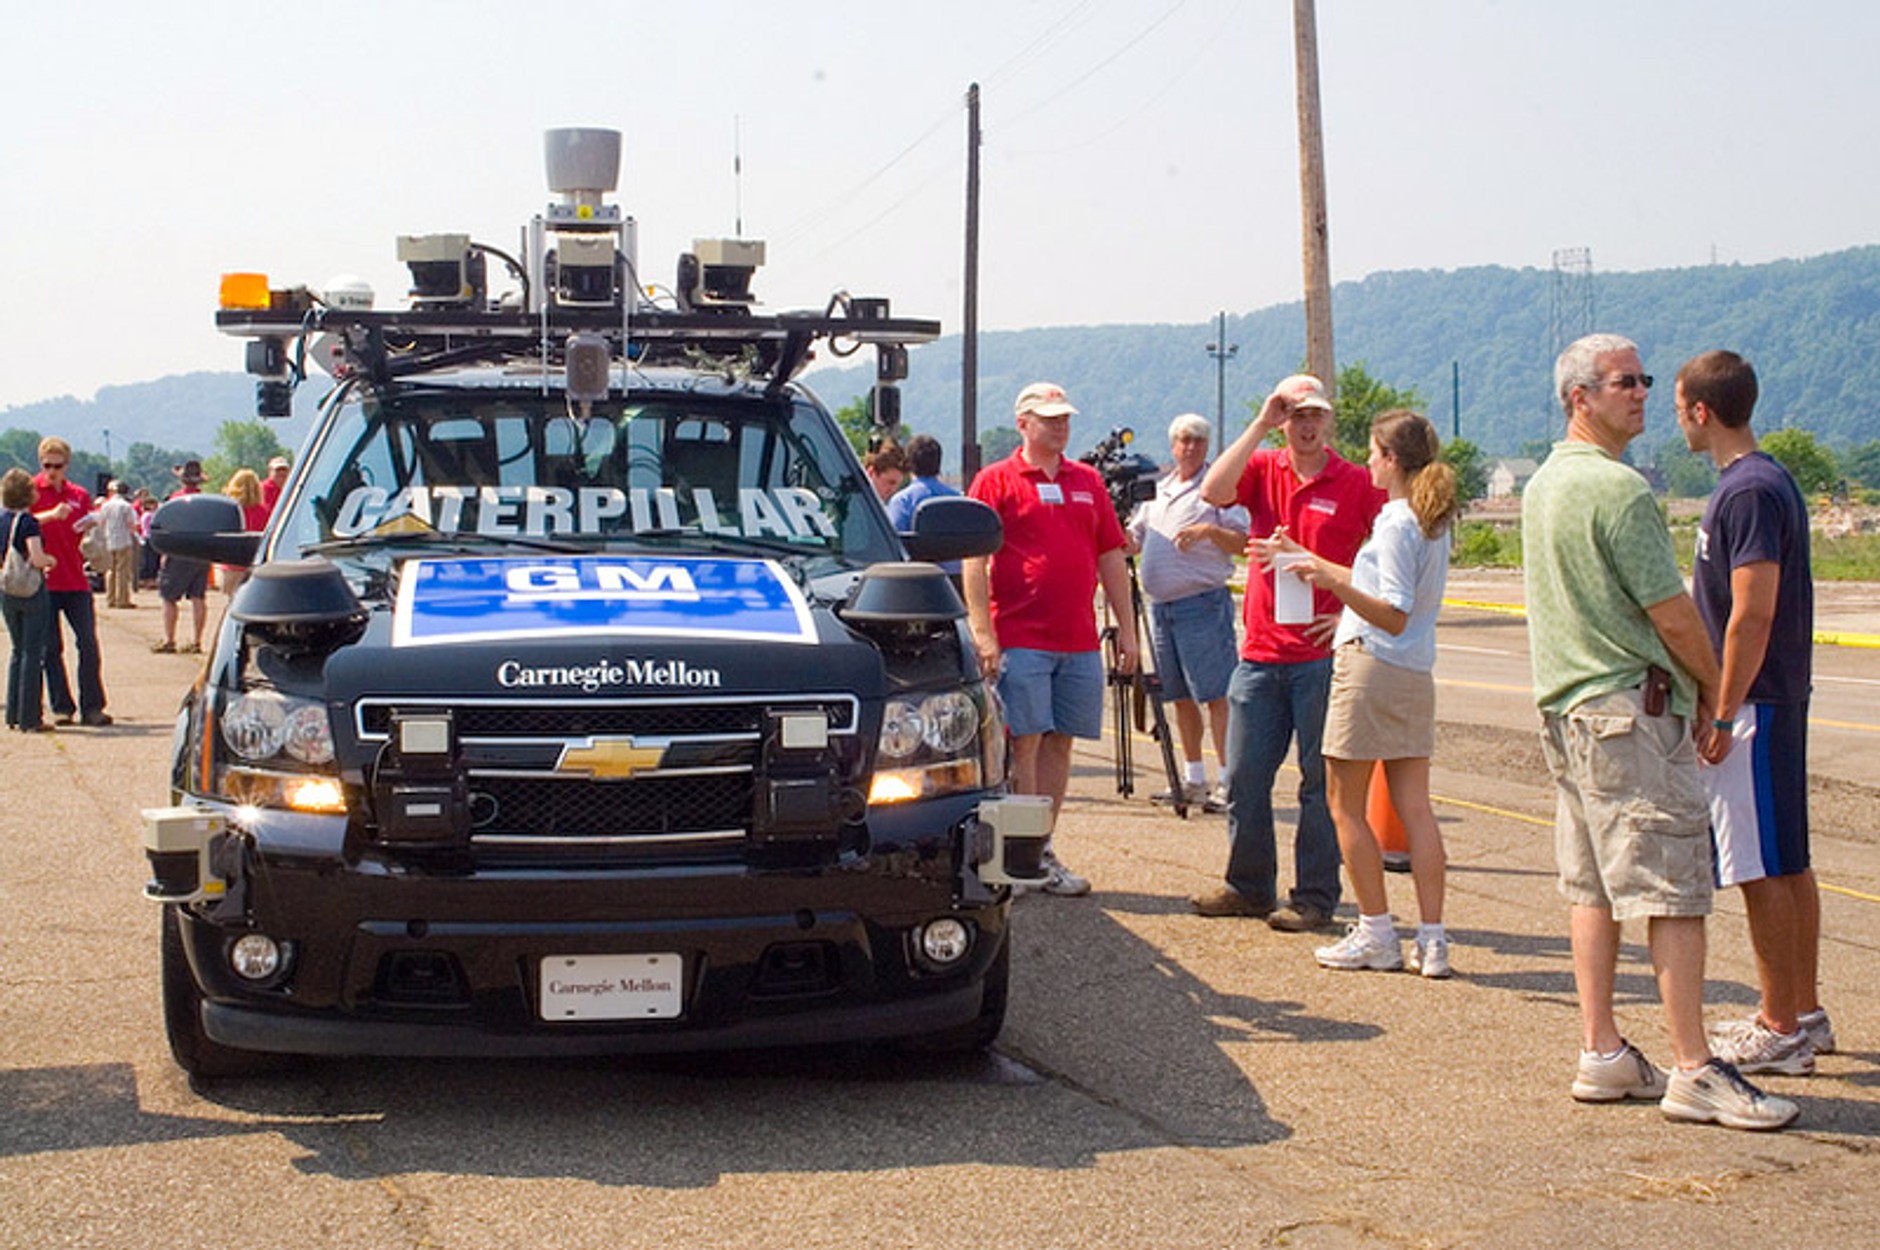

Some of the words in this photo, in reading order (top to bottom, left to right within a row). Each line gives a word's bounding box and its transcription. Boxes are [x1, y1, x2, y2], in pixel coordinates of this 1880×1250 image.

[332, 485, 839, 538] CATERPILLAR
[506, 566, 698, 592] GM
[498, 660, 624, 692] Carnegie
[626, 660, 721, 687] Mellon
[549, 979, 615, 997] Carnegie
[620, 978, 671, 993] Mellon
